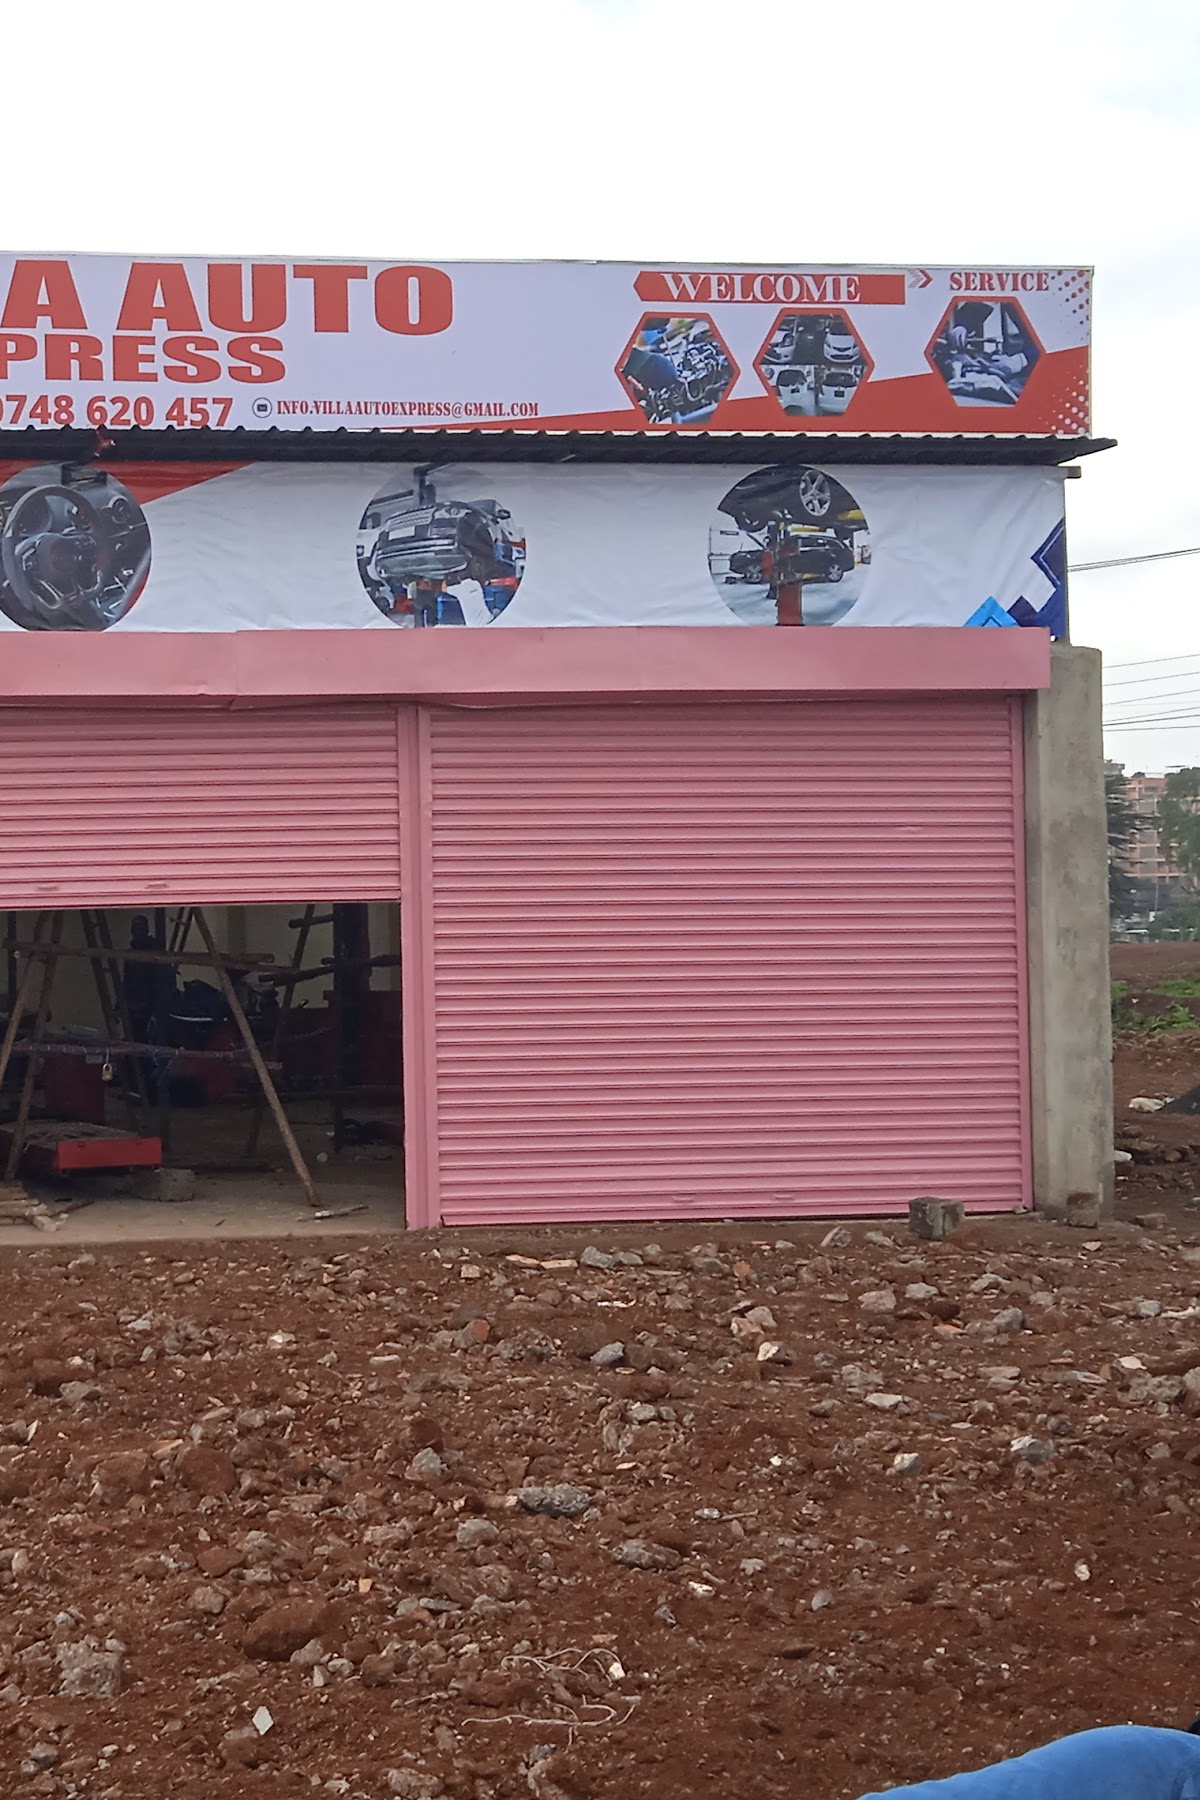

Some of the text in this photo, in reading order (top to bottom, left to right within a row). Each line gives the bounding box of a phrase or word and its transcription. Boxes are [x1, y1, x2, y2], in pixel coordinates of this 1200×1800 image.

[660, 272, 861, 302] WELCOME
[949, 271, 1050, 292] SERVICE
[117, 262, 454, 335] AUTO
[86, 396, 156, 427] 620
[164, 396, 234, 427] 457
